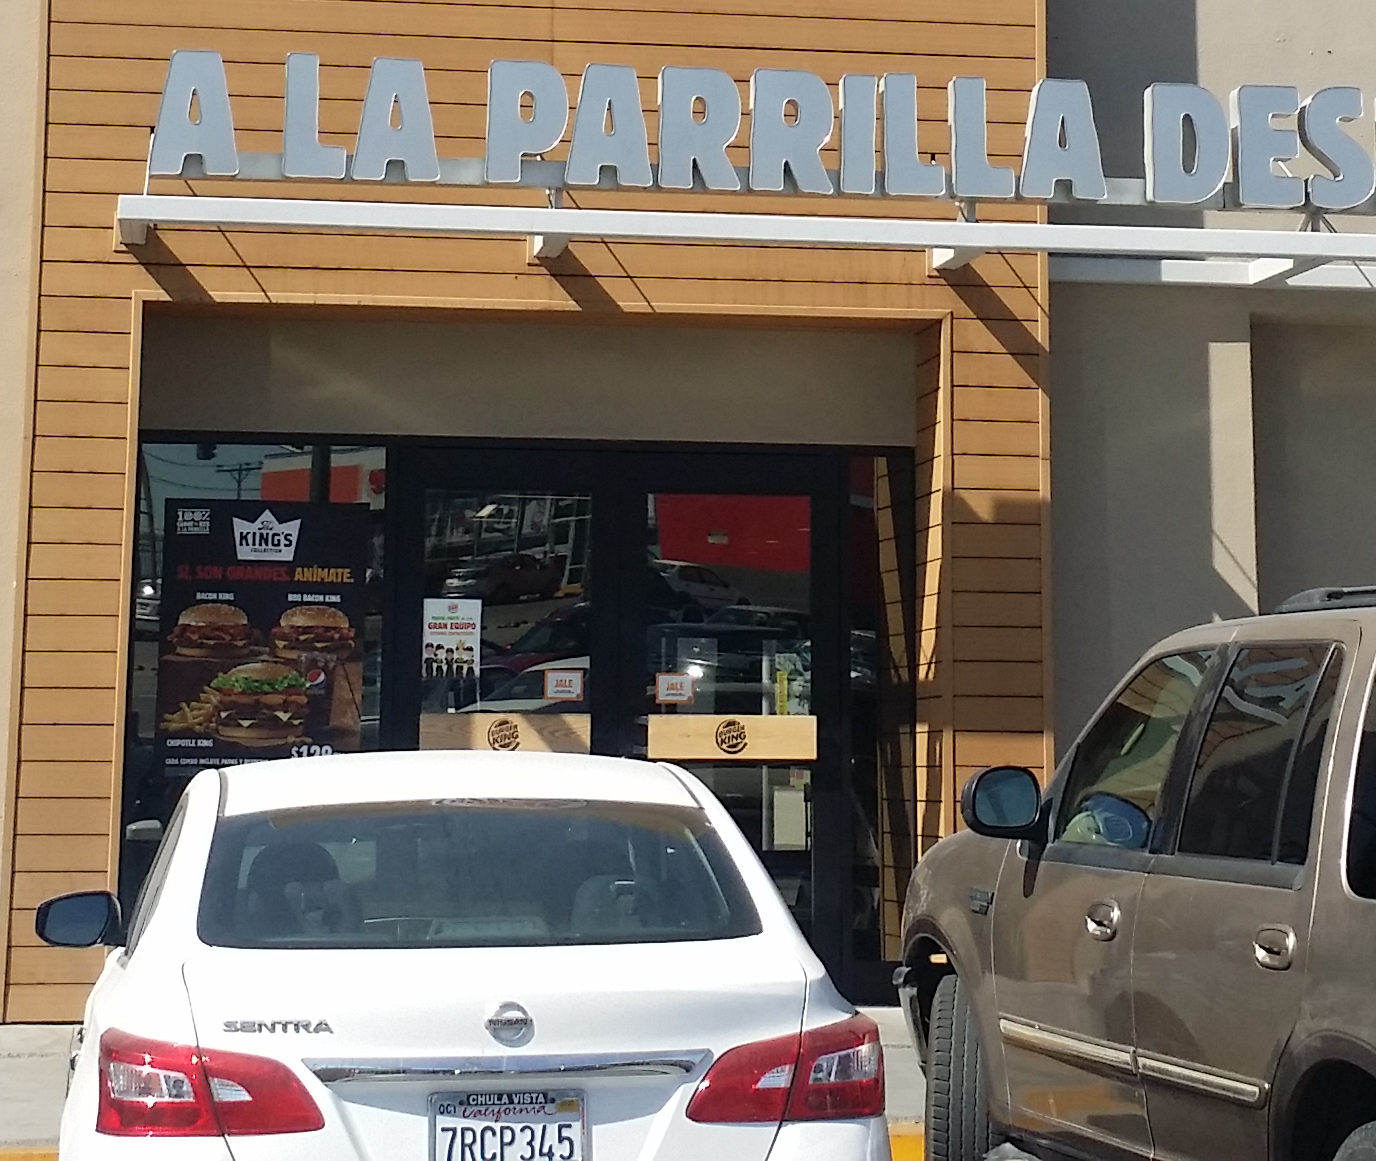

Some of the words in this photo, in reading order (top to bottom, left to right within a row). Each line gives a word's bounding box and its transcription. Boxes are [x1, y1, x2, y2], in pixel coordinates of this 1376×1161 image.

[151, 49, 239, 177] A
[284, 52, 440, 183] LA
[484, 58, 1107, 201] PARRILLA
[239, 531, 293, 548] KING'S
[428, 622, 448, 630] GRAN
[720, 731, 747, 747] KING
[223, 1020, 335, 1034] SENTRA
[469, 1094, 509, 1105] CHULA
[513, 1093, 545, 1104] VISTA
[462, 1105, 556, 1123] California
[440, 1123, 575, 1161] 7RCP345
